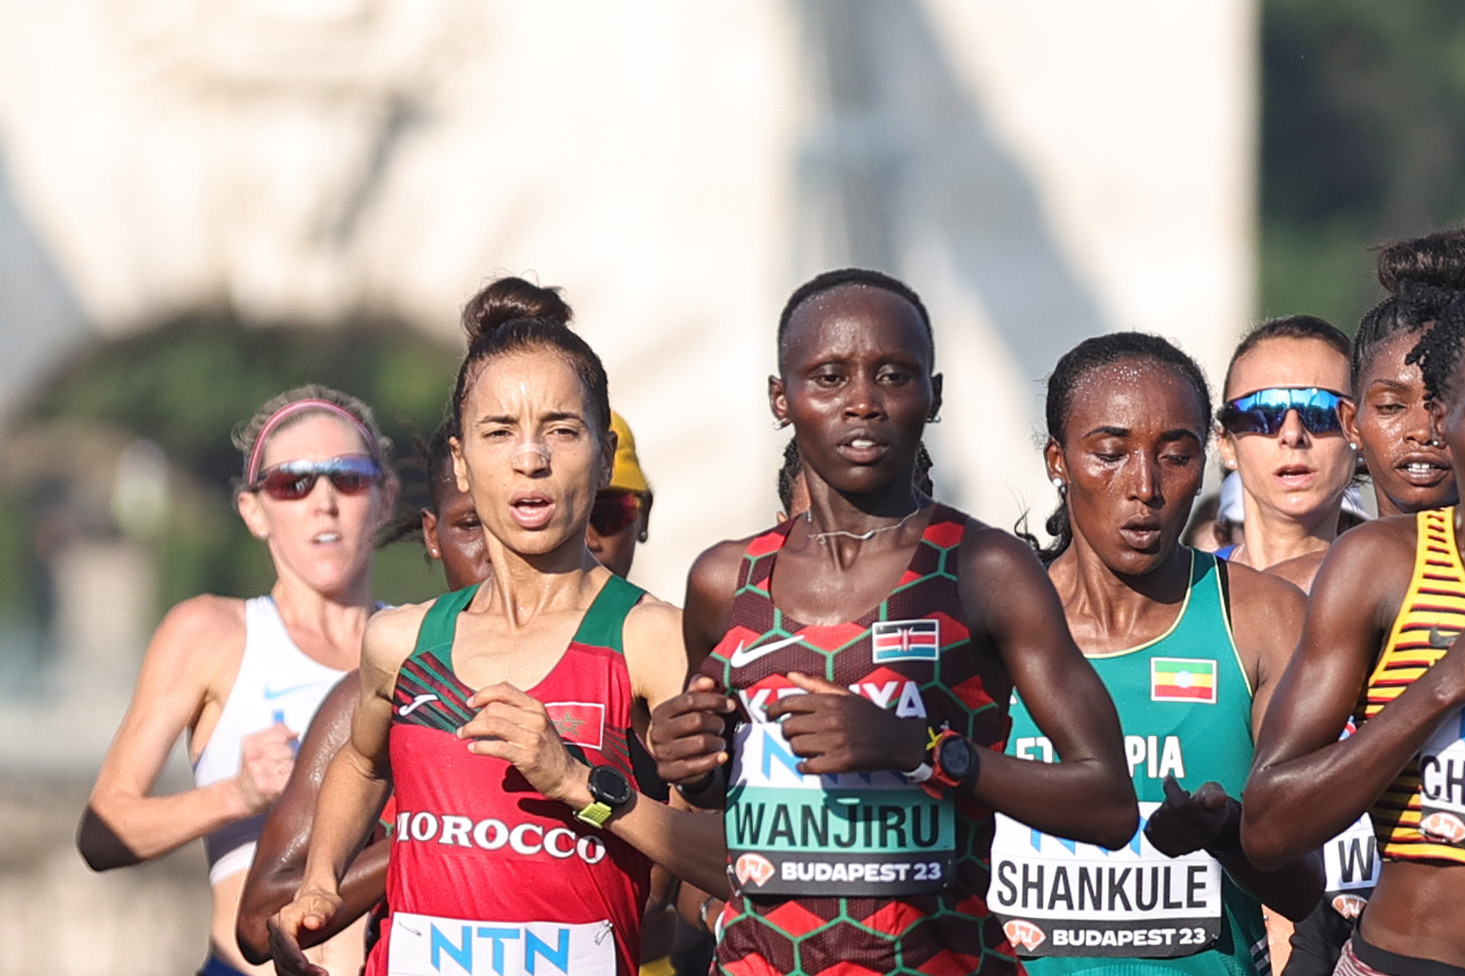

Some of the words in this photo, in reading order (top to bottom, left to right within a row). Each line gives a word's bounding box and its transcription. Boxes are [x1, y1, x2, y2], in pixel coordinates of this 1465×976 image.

[734, 803, 939, 848] WANJIRU
[781, 862, 910, 882] BUDAPEST
[913, 862, 942, 881] 23
[997, 860, 1208, 911] SHANKULE
[1052, 929, 1176, 947] BUDAPEST
[1179, 928, 1206, 945] 23
